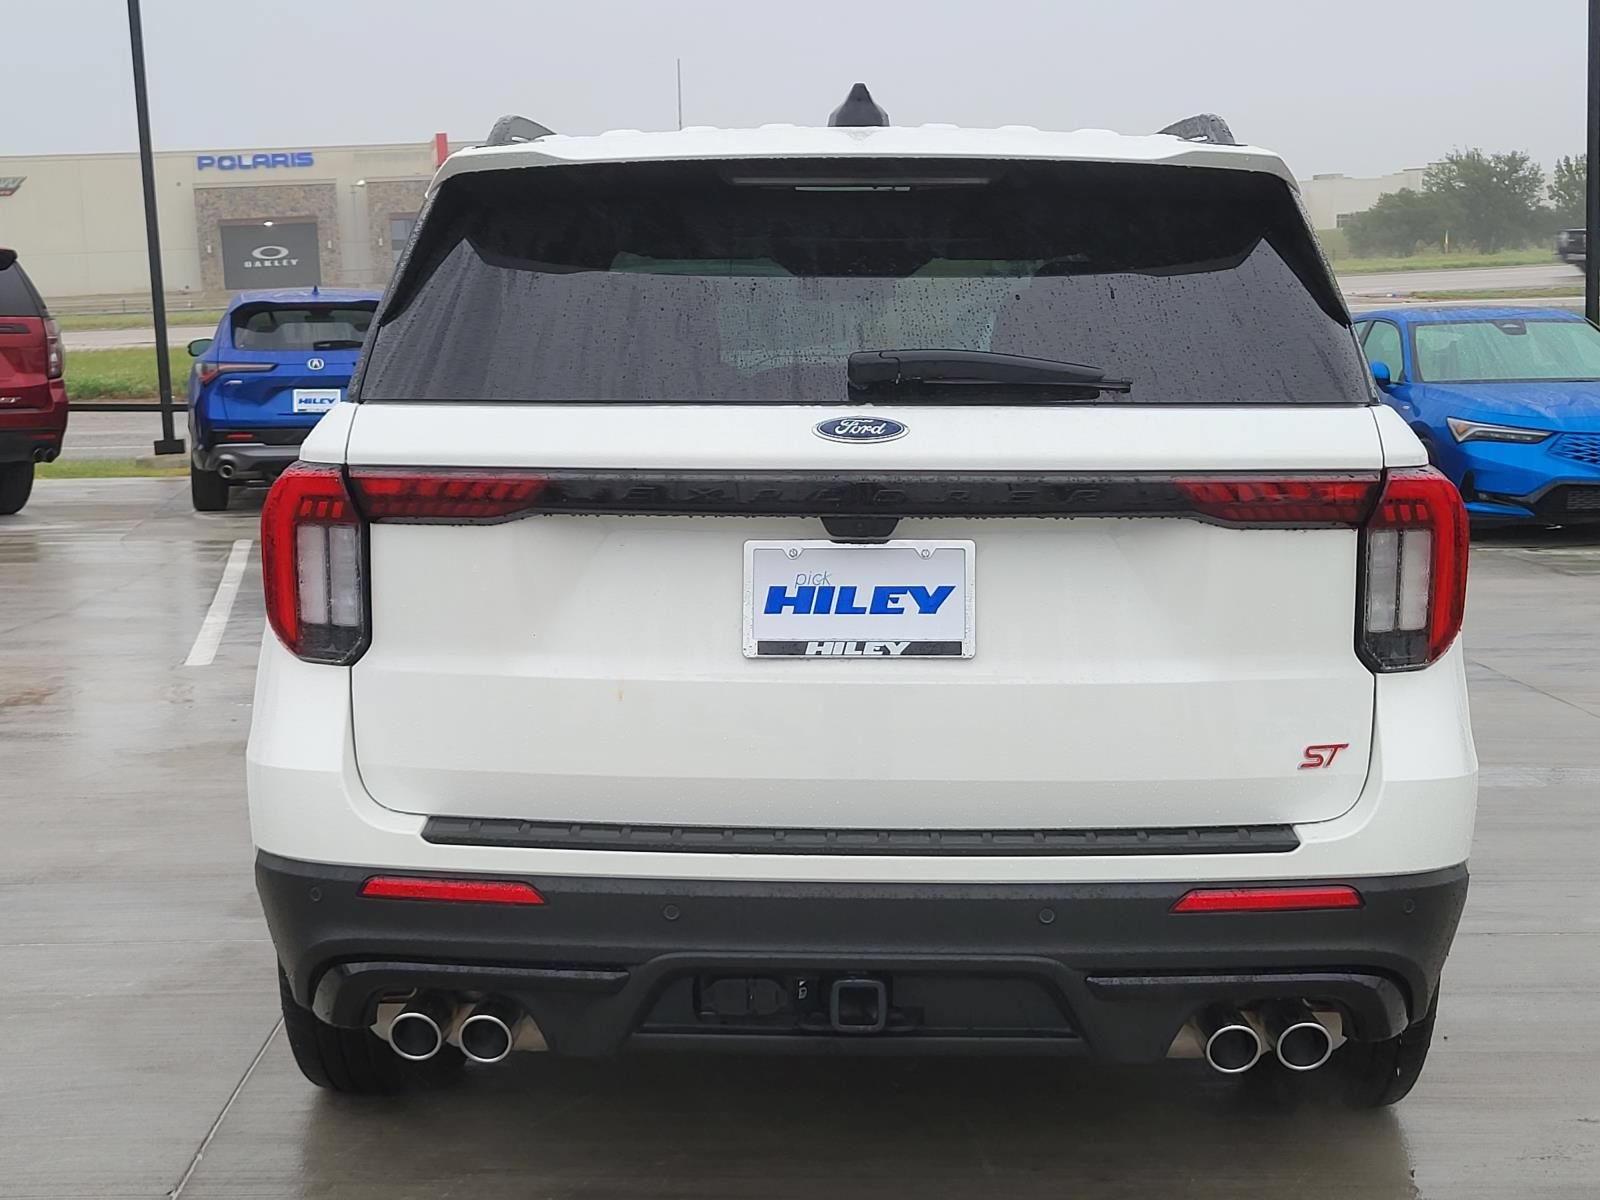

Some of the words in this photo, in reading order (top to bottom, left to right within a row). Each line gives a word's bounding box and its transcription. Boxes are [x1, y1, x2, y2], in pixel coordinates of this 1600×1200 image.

[197, 152, 314, 171] POLARIS
[243, 258, 298, 268] OAKLEY
[835, 418, 886, 435] Ford
[794, 571, 832, 588] pick
[763, 585, 956, 615] HILEY
[805, 641, 911, 656] HILEY
[1297, 743, 1350, 769] ST
